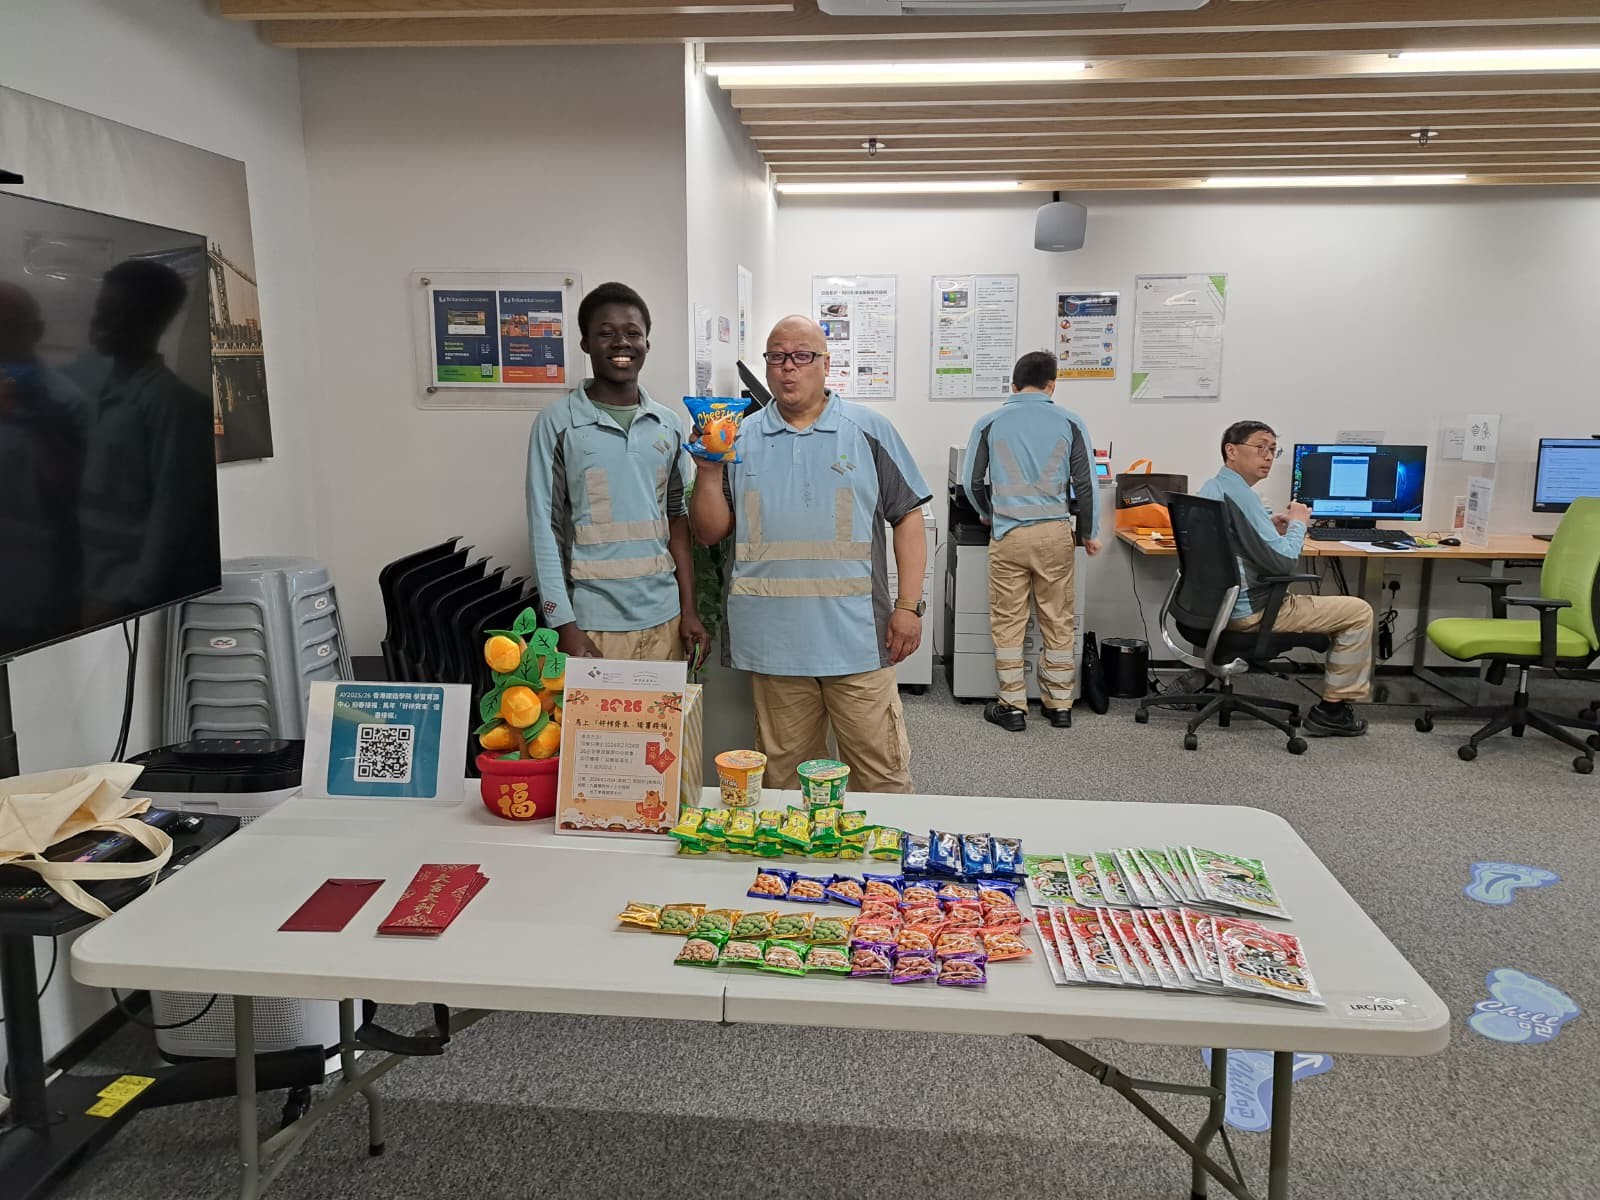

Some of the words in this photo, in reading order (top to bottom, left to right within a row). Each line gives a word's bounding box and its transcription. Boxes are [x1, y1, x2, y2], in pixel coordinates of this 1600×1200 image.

[600, 699, 643, 713] 2026
[497, 782, 537, 818] 福
[1350, 1003, 1394, 1012] LRC/SD
[1476, 1001, 1560, 1026] Chill
